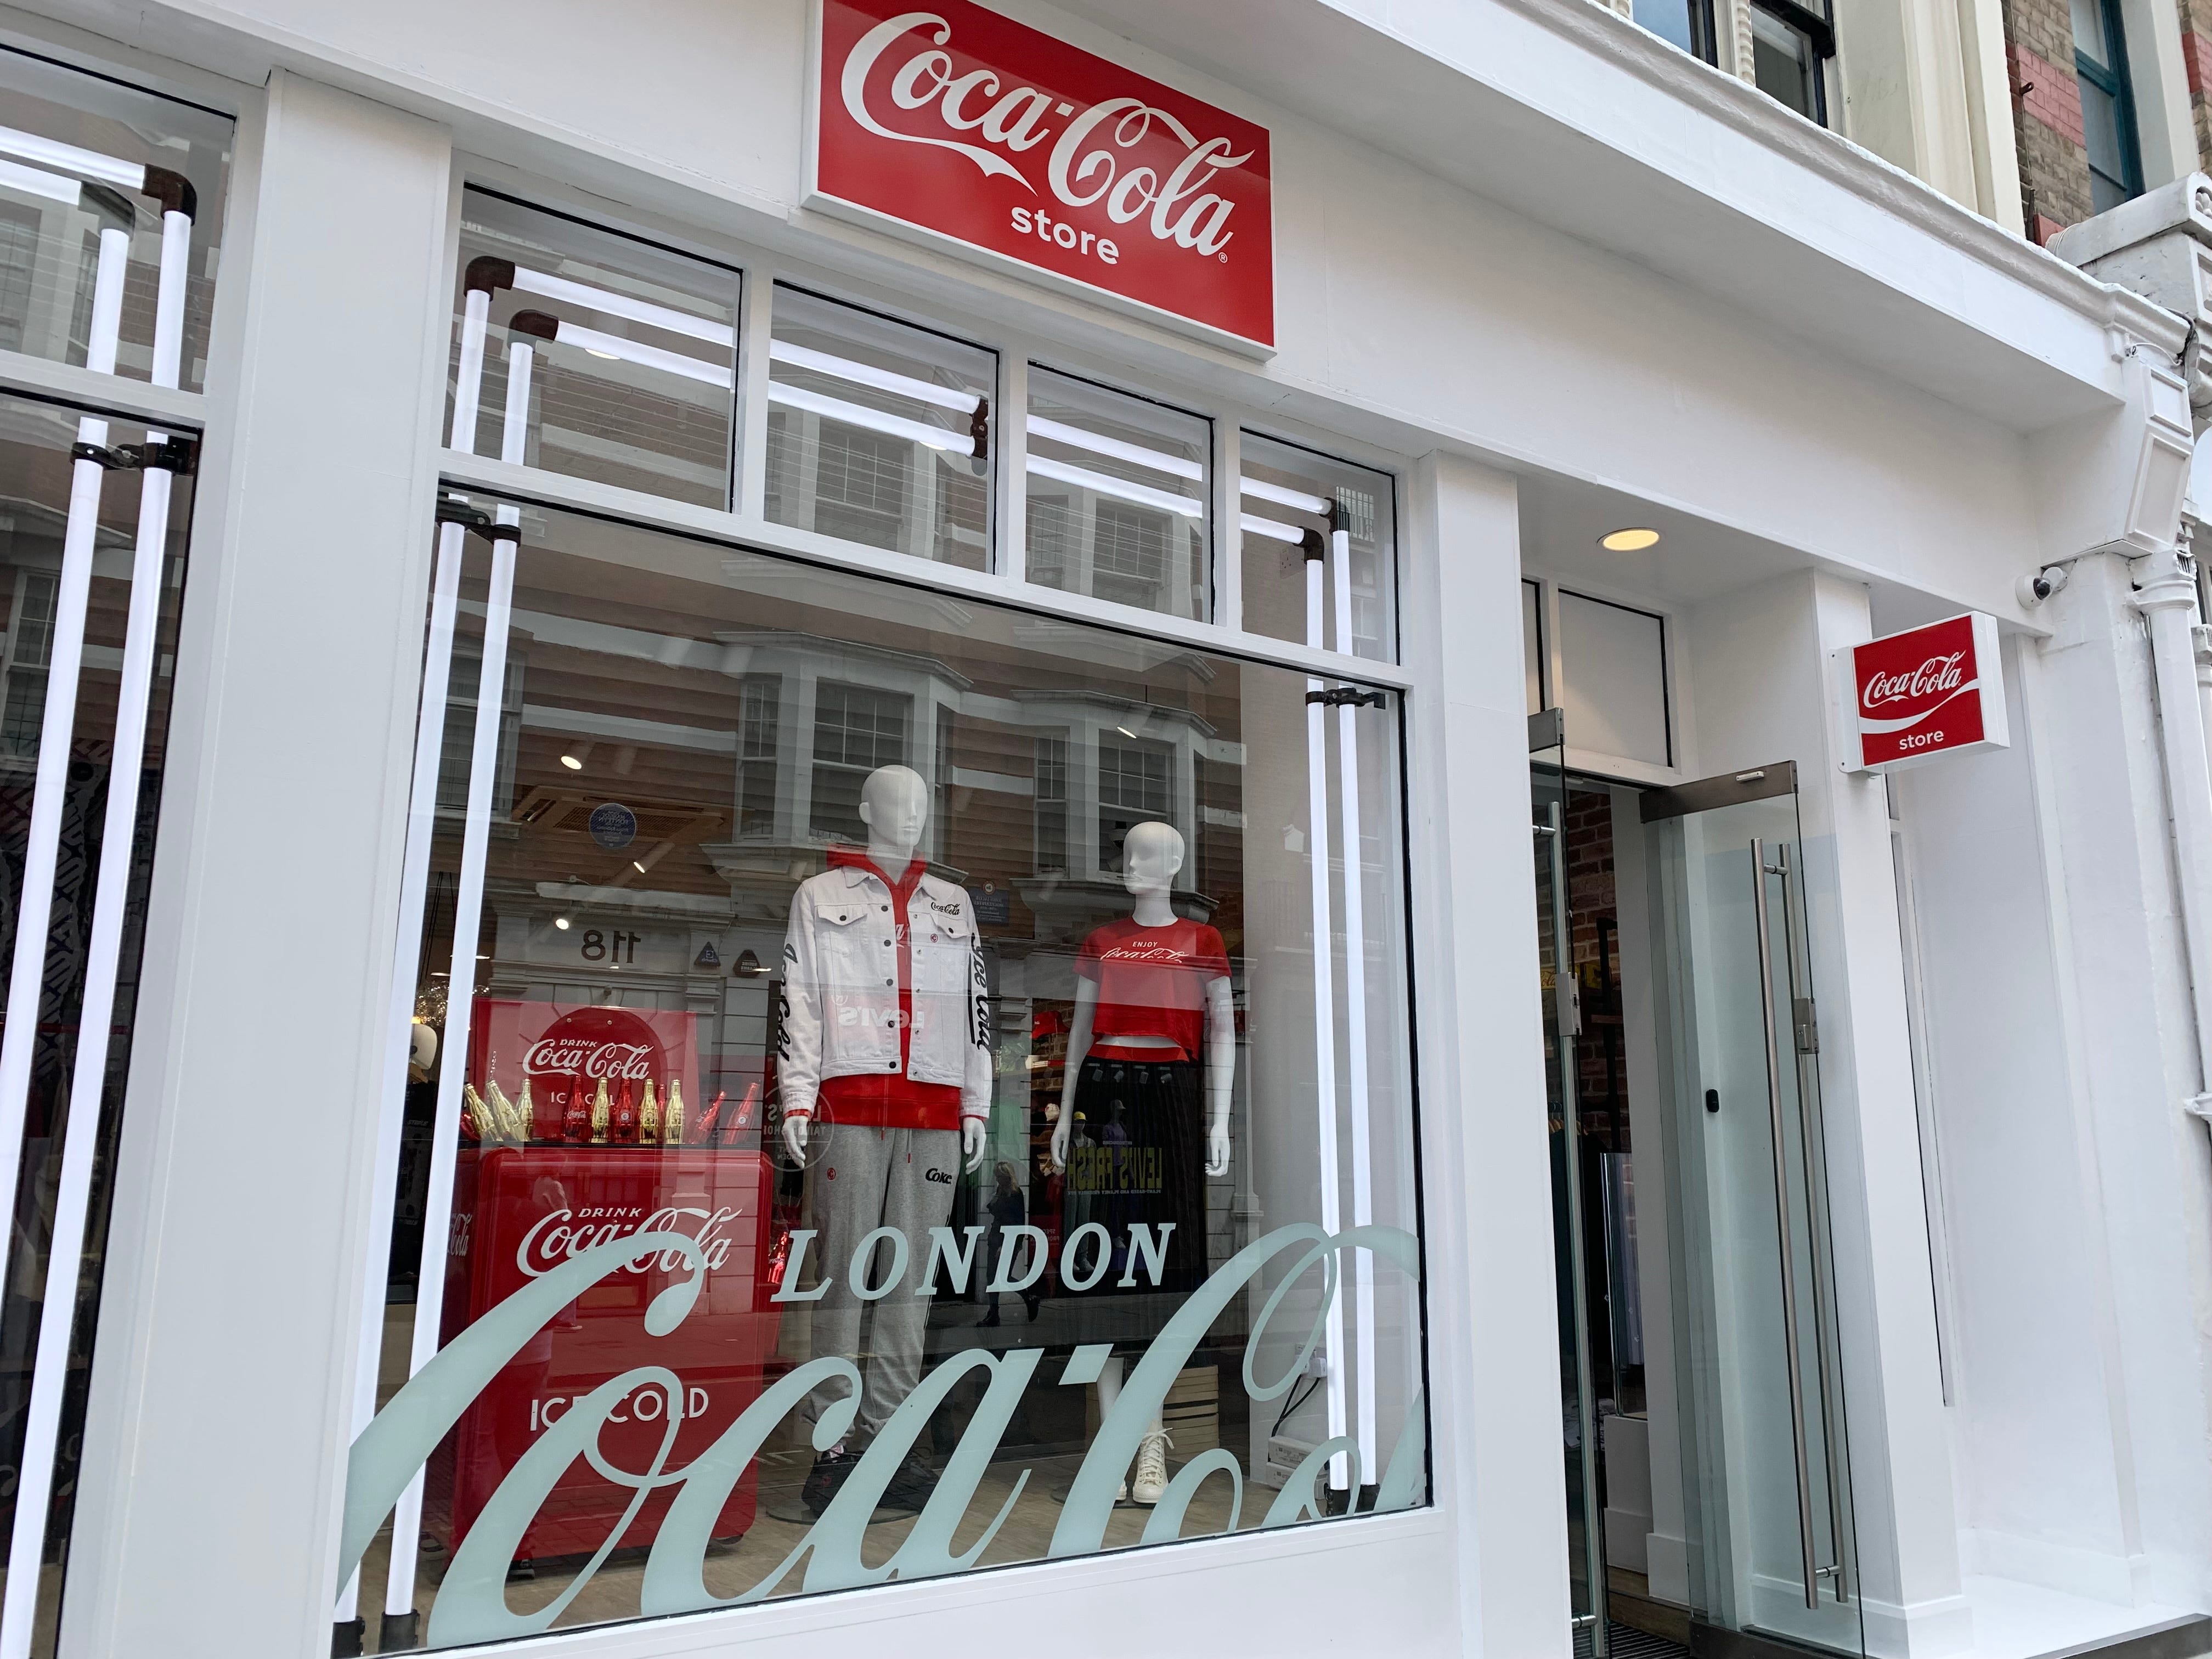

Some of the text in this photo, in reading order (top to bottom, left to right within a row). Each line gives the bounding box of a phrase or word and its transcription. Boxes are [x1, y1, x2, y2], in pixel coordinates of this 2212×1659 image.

[841, 12, 1256, 256] Coca-Cola
[1011, 205, 1119, 265] store
[1863, 650, 1967, 708] Coca-Cola
[1899, 730, 1944, 750] store
[931, 902, 961, 916] Coca-Cola
[560, 1039, 597, 1048] DRINK
[522, 1039, 654, 1080] Coca-Cola
[551, 1091, 566, 1104] IC
[925, 1168, 952, 1184] Coke
[578, 1207, 642, 1218] DRINK
[770, 1222, 1176, 1302] LONDON
[530, 1395, 588, 1431] IC
